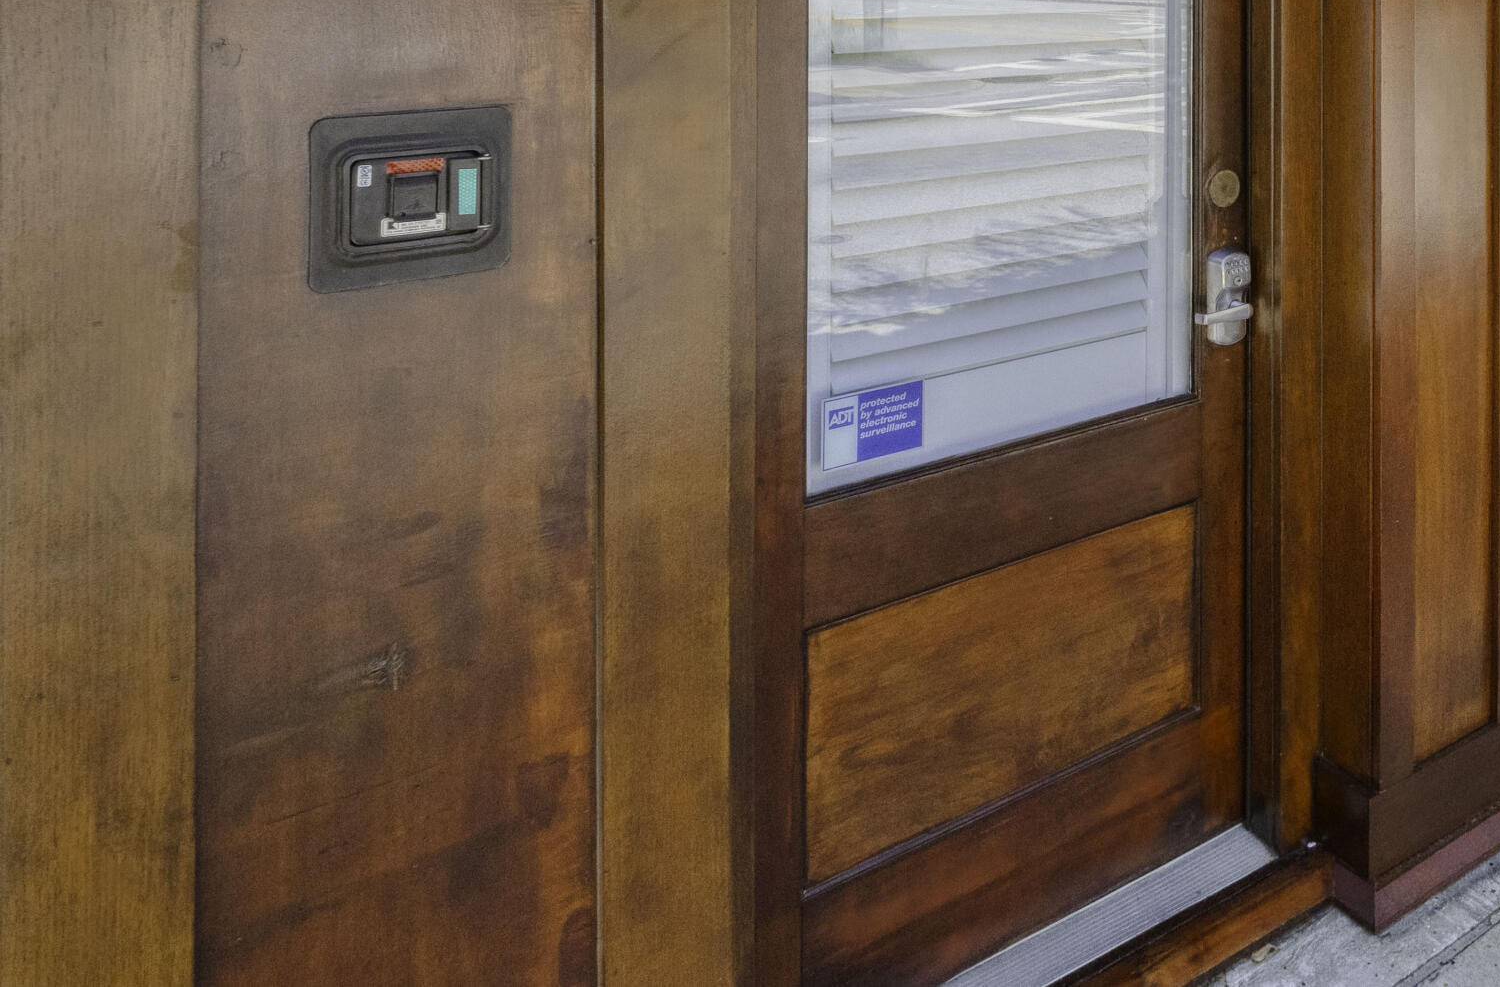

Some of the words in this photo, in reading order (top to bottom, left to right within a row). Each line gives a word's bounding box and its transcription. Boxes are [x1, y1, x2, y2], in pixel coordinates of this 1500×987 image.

[860, 392, 907, 411] protected
[860, 411, 873, 421] by
[874, 398, 920, 417] advanced
[829, 409, 853, 428] ADT
[860, 412, 908, 429] electronic
[860, 420, 917, 439] surveillance
